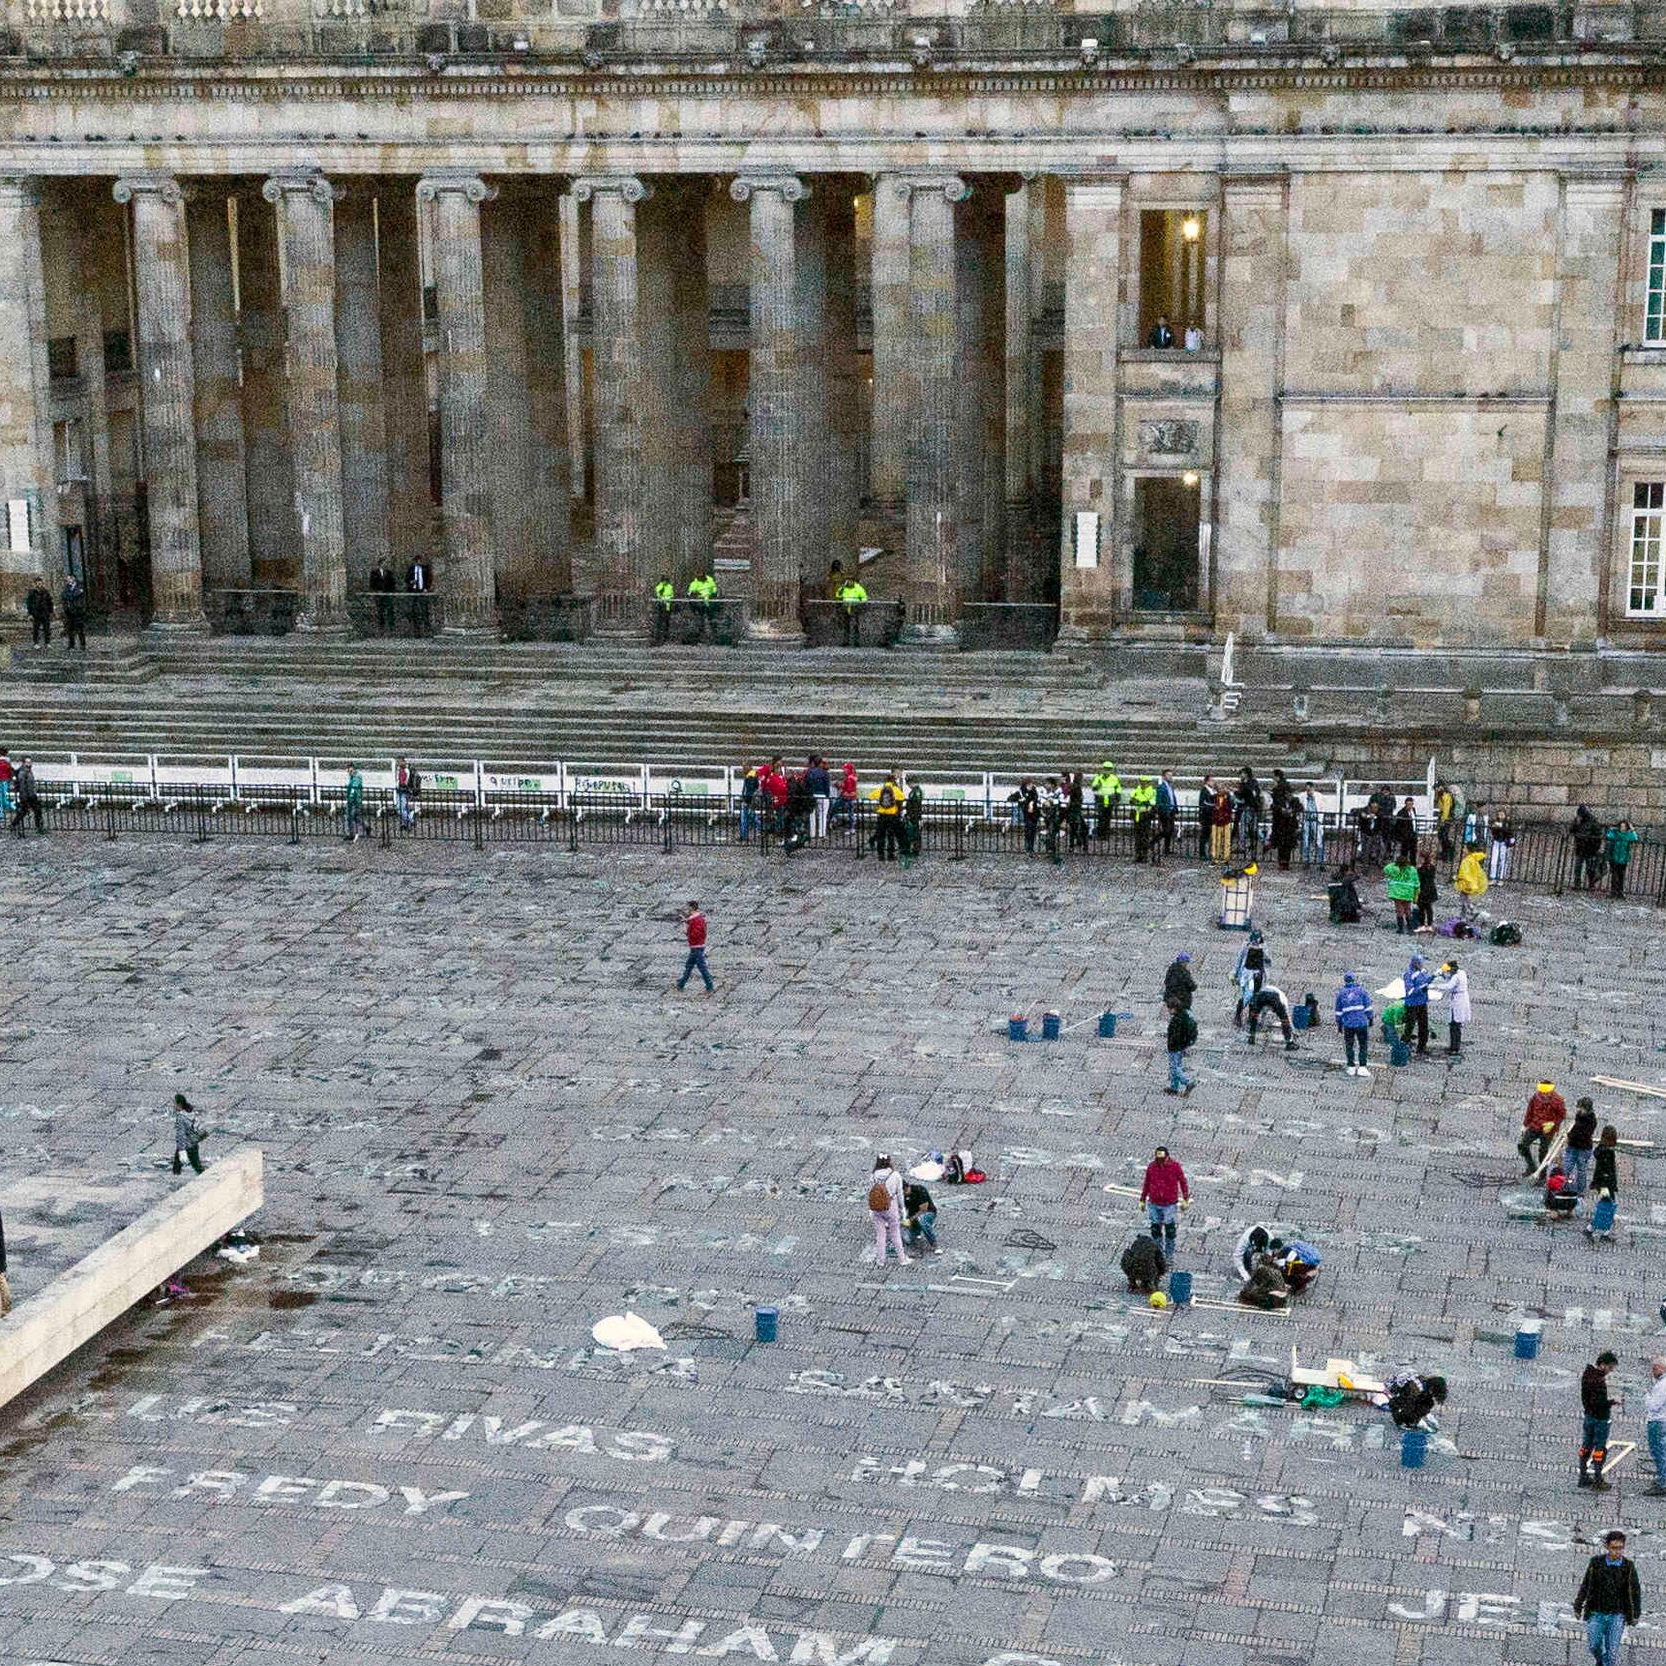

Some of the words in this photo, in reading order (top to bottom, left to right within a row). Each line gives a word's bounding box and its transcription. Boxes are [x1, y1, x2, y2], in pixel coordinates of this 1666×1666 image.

[367, 1407, 677, 1462] RIVAS
[110, 1464, 471, 1515] FREDY
[563, 1502, 1119, 1586] QUINTERO
